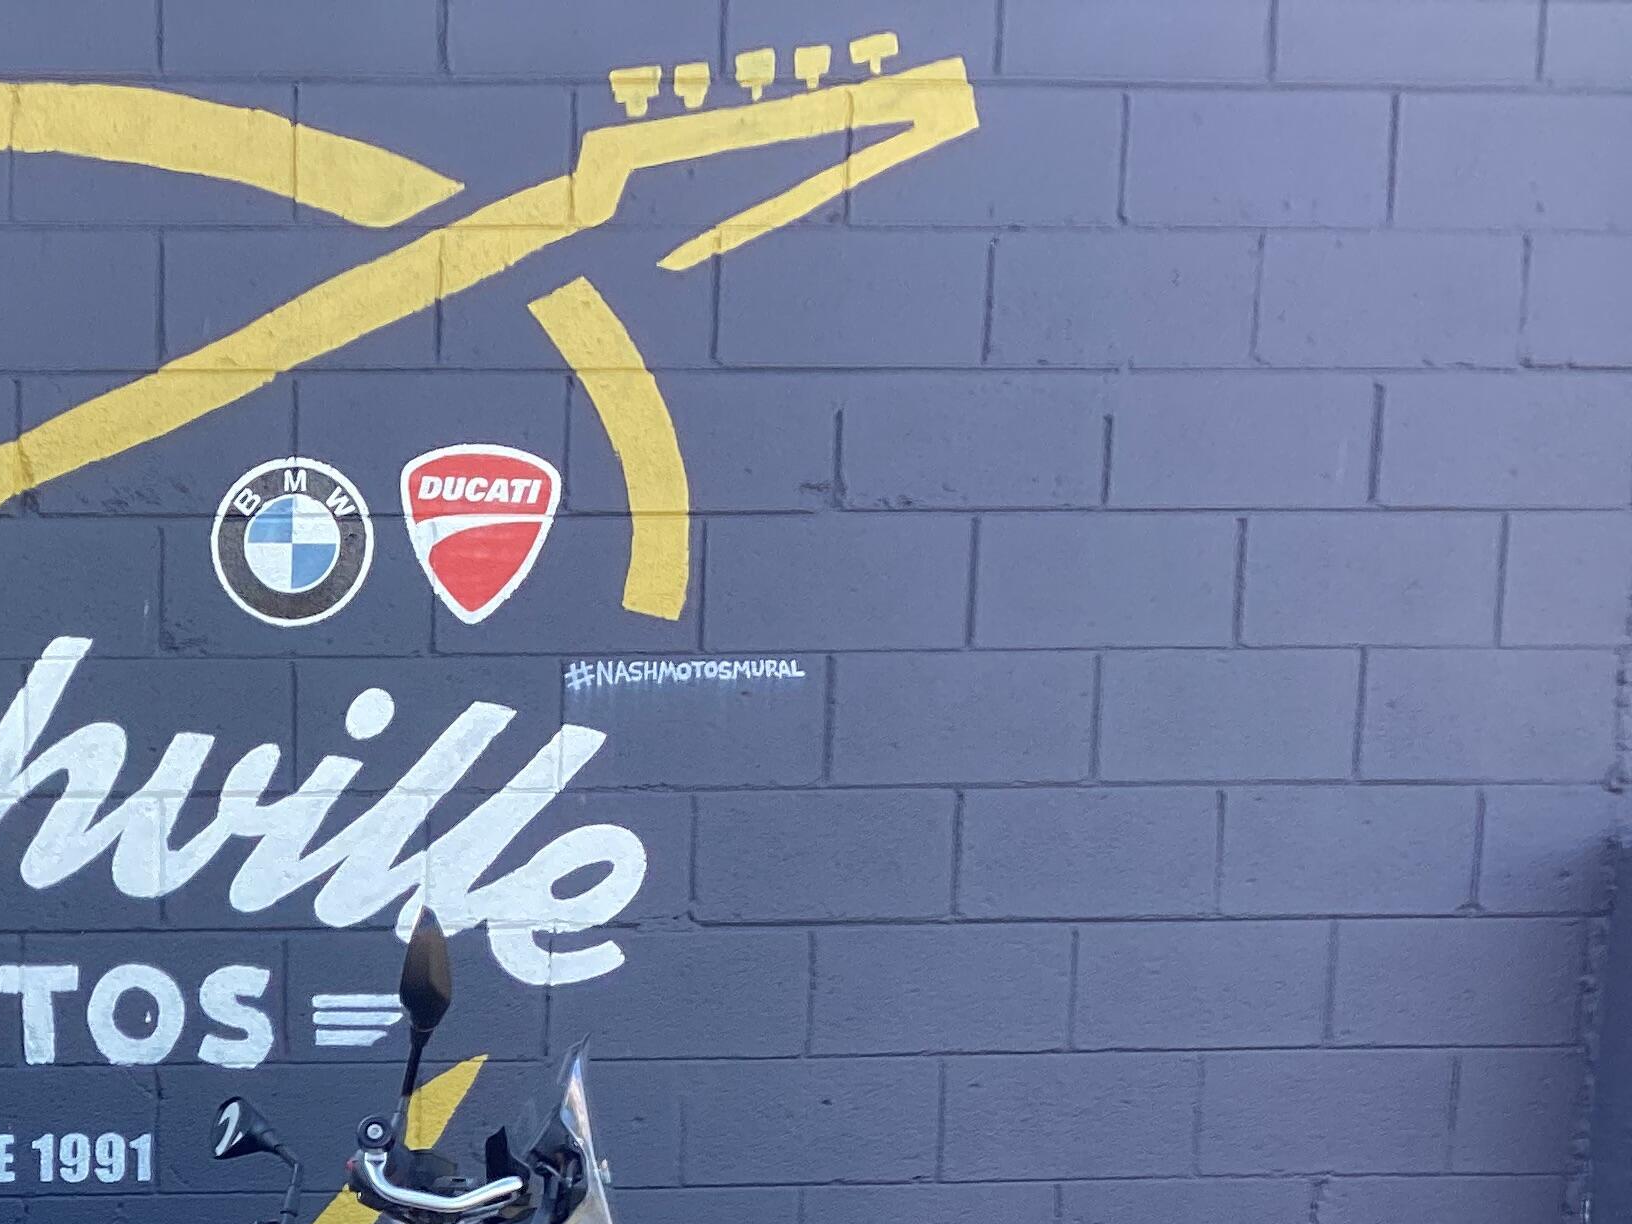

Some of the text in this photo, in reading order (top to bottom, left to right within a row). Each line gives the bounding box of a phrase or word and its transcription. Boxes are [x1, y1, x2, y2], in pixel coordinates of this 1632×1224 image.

[233, 468, 356, 518] BMW
[417, 475, 543, 504] DUCATI
[564, 658, 806, 691] #NASHMOTOSMURAL
[31, 1131, 153, 1183] 1991
